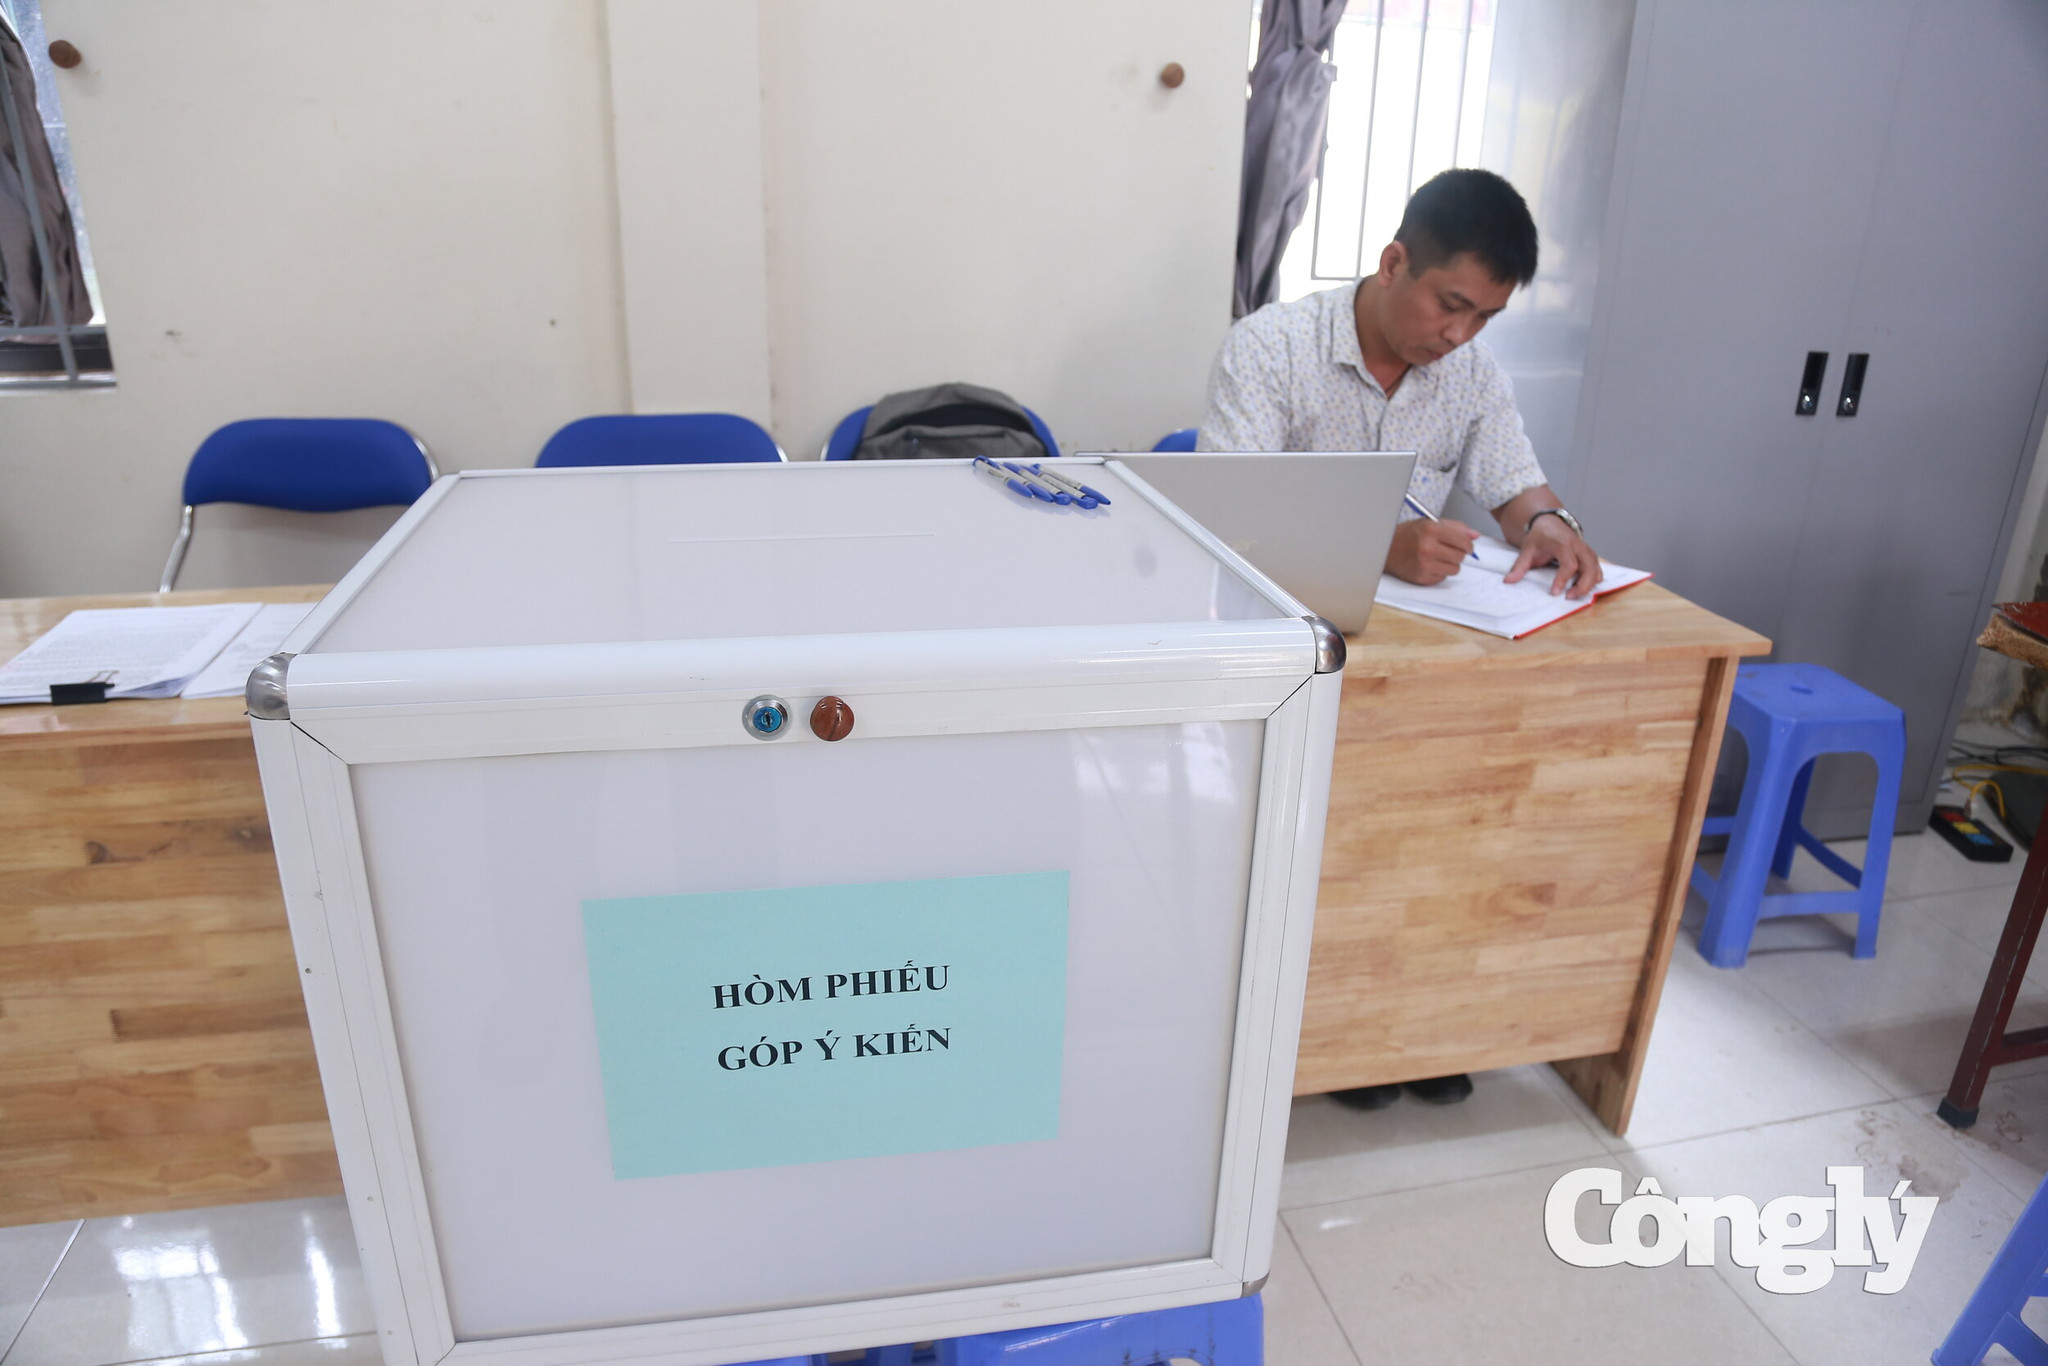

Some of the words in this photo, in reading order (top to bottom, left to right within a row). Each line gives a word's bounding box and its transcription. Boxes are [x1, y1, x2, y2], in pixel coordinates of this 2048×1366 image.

[711, 974, 813, 1009] HÒM
[825, 960, 950, 999] PHIẾU
[717, 1036, 803, 1071] GÓP
[813, 1030, 841, 1061] Ý
[853, 1023, 952, 1058] KIẾN
